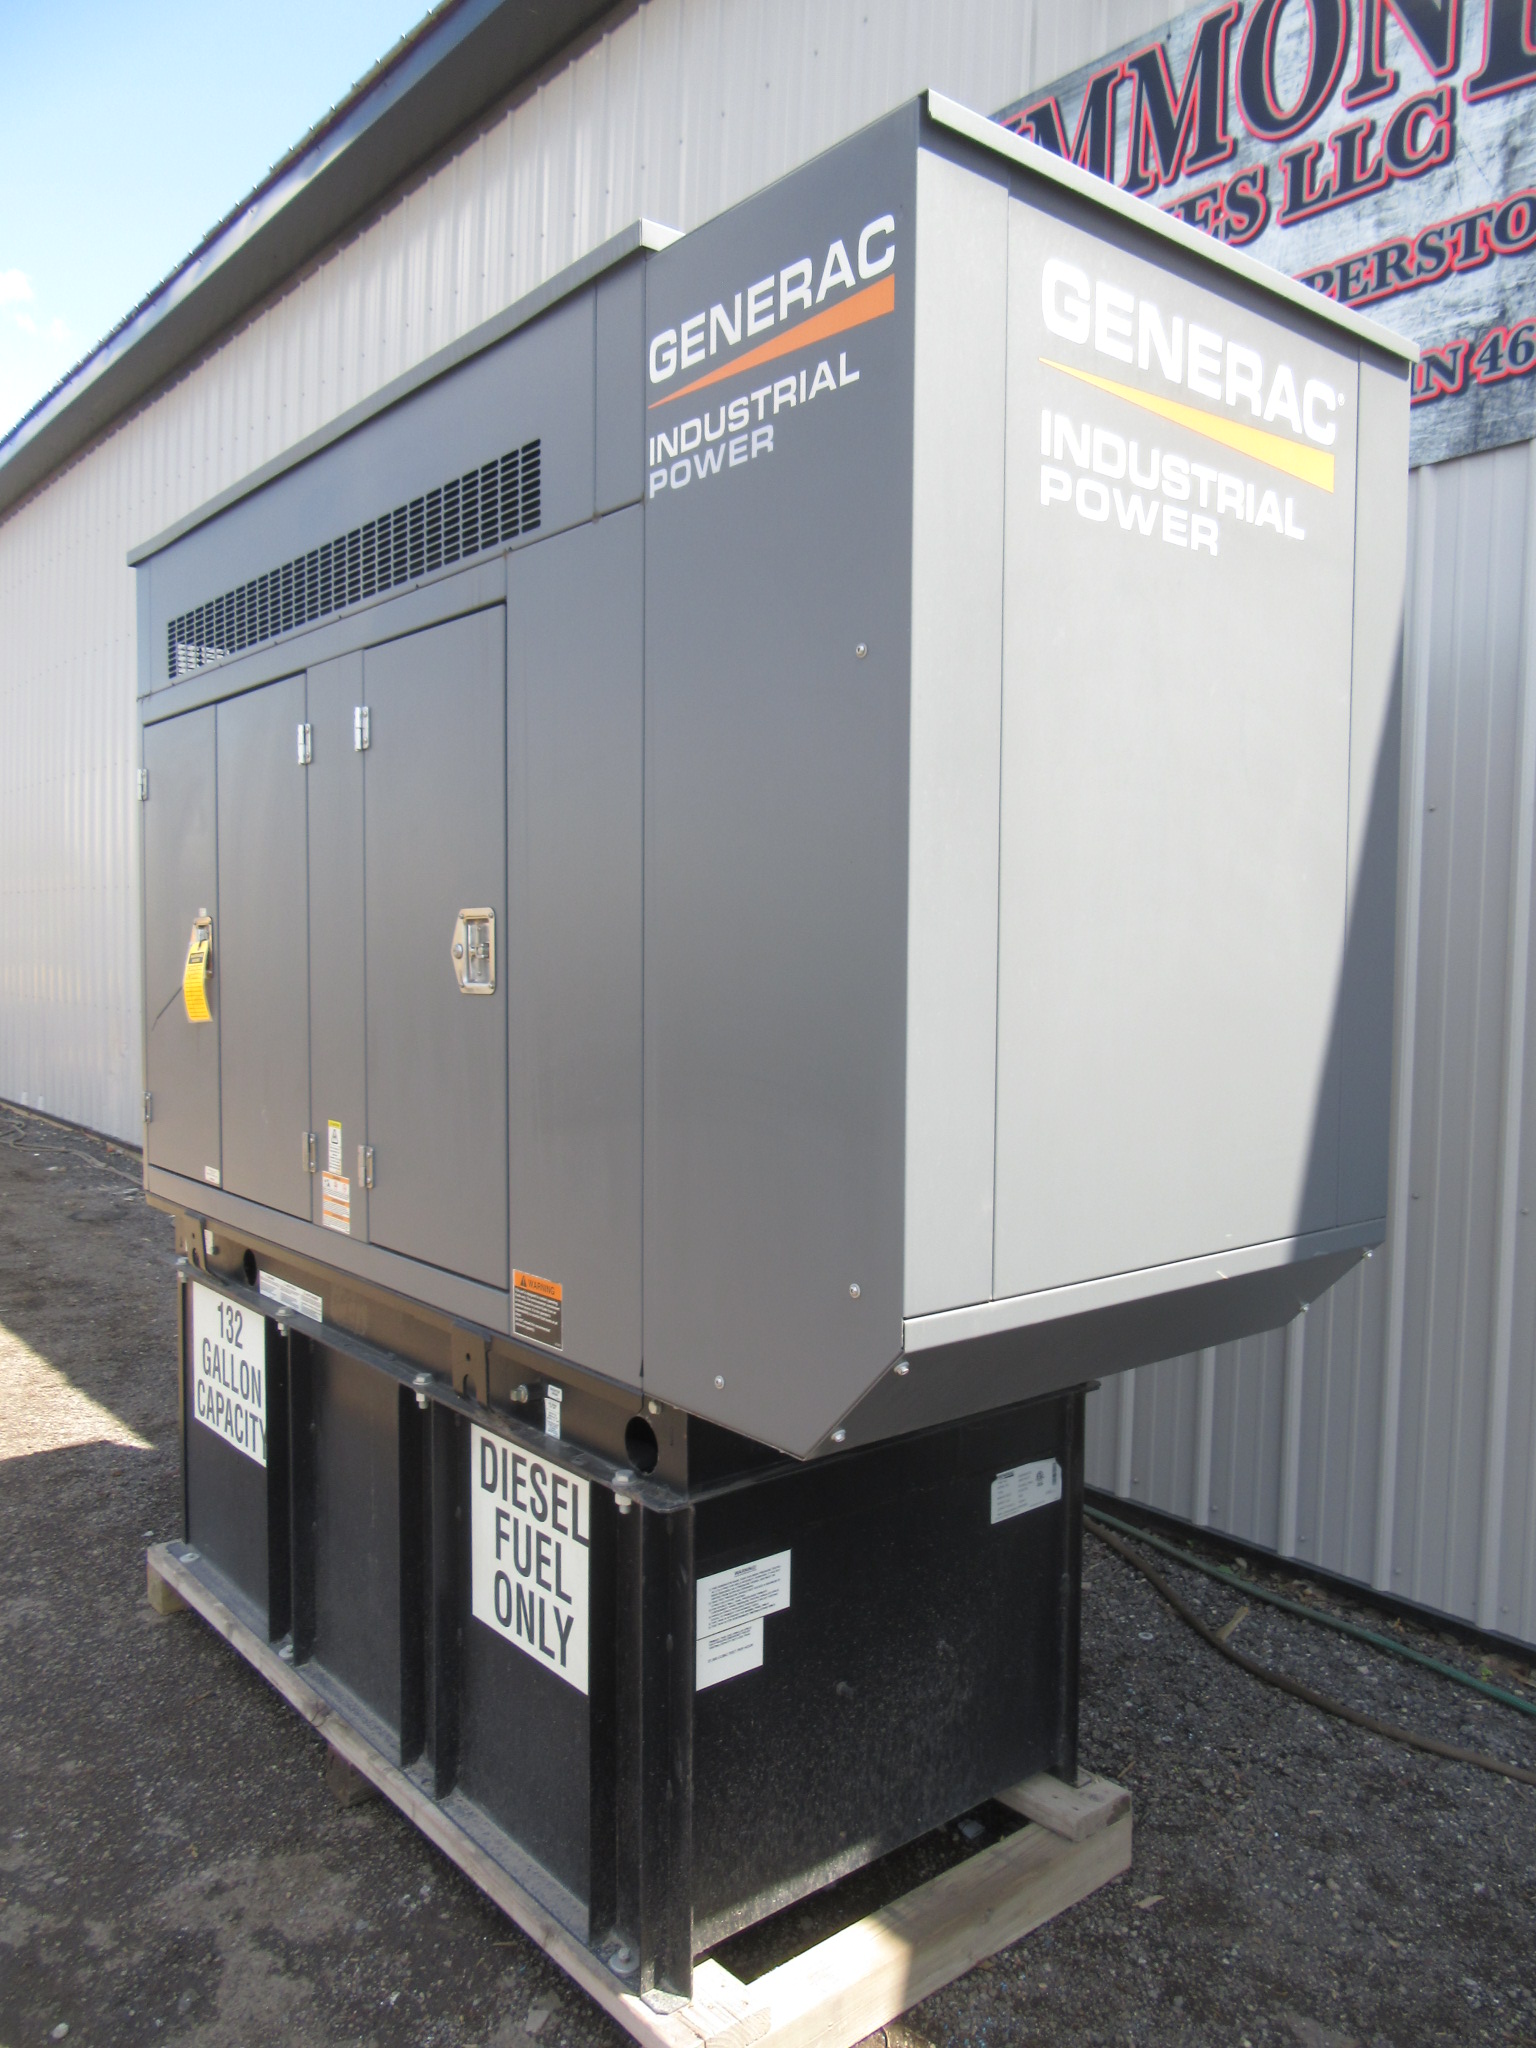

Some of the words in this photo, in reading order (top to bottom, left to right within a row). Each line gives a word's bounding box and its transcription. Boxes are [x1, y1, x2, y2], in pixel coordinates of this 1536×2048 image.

[1278, 84, 1456, 227] LLC
[649, 213, 896, 384] GENERAC
[1470, 318, 1536, 384] 46
[649, 351, 860, 466] INDUSTRIAL
[649, 424, 775, 499] POWER
[1040, 408, 1306, 541] INDUSTRIAL
[1040, 464, 1219, 557] POWER
[218, 1301, 244, 1350] 132
[527, 1279, 556, 1296] WARNING
[202, 1337, 262, 1409] GALLON
[480, 1436, 590, 1548] DIESEL
[495, 1507, 573, 1606] FUEL
[494, 1569, 575, 1669] ONLY
